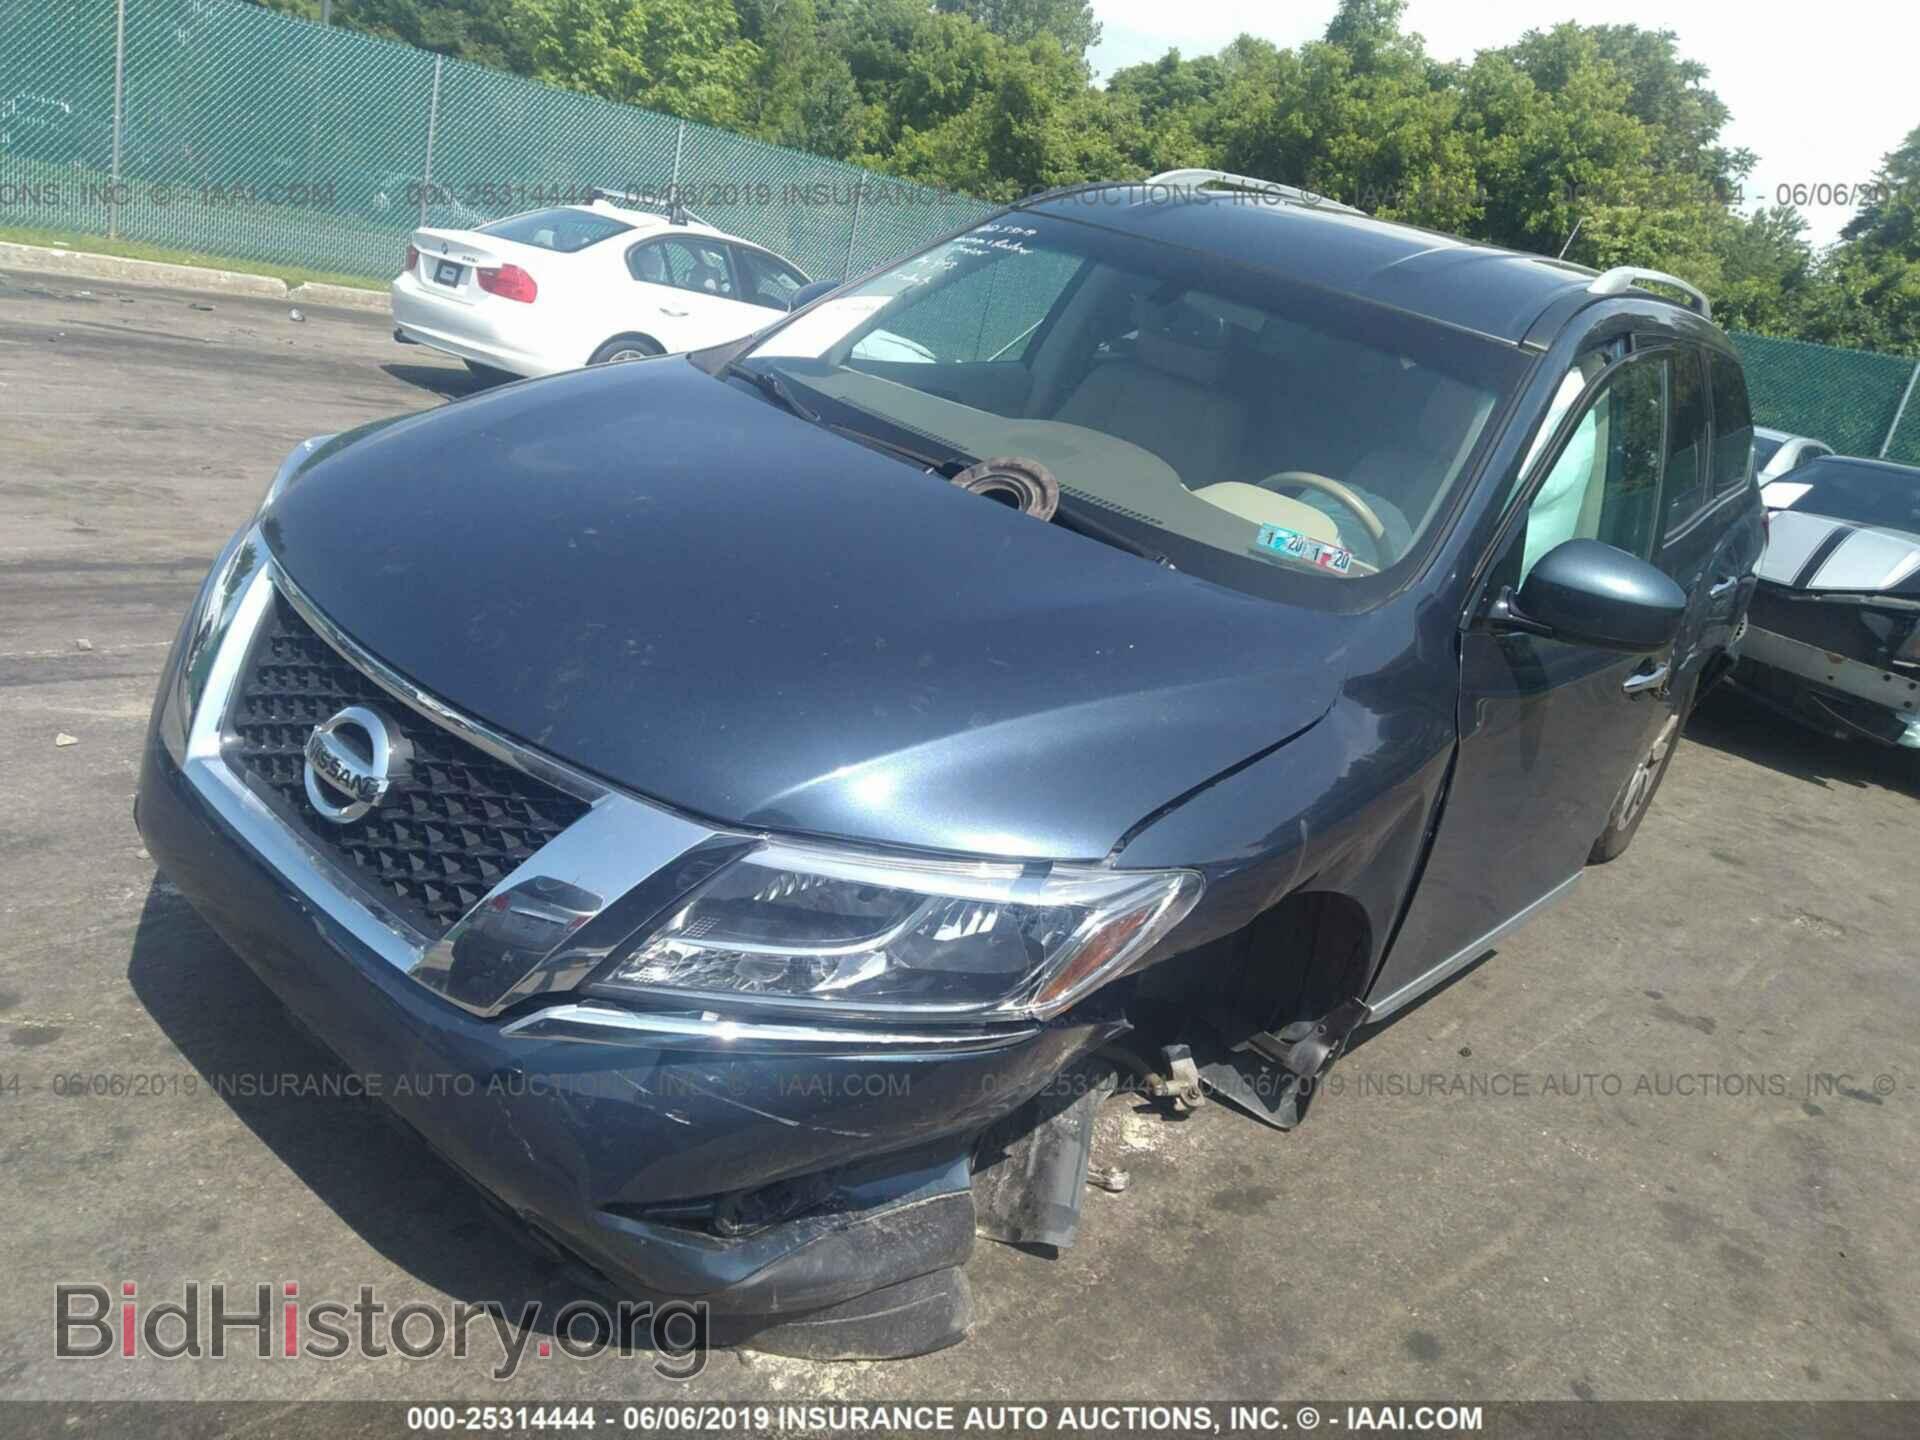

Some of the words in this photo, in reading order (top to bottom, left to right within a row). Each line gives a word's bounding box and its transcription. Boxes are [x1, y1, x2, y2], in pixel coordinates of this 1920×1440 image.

[1288, 534, 1304, 553] 20
[1334, 550, 1351, 569] 20
[308, 743, 371, 797] ISSAN
